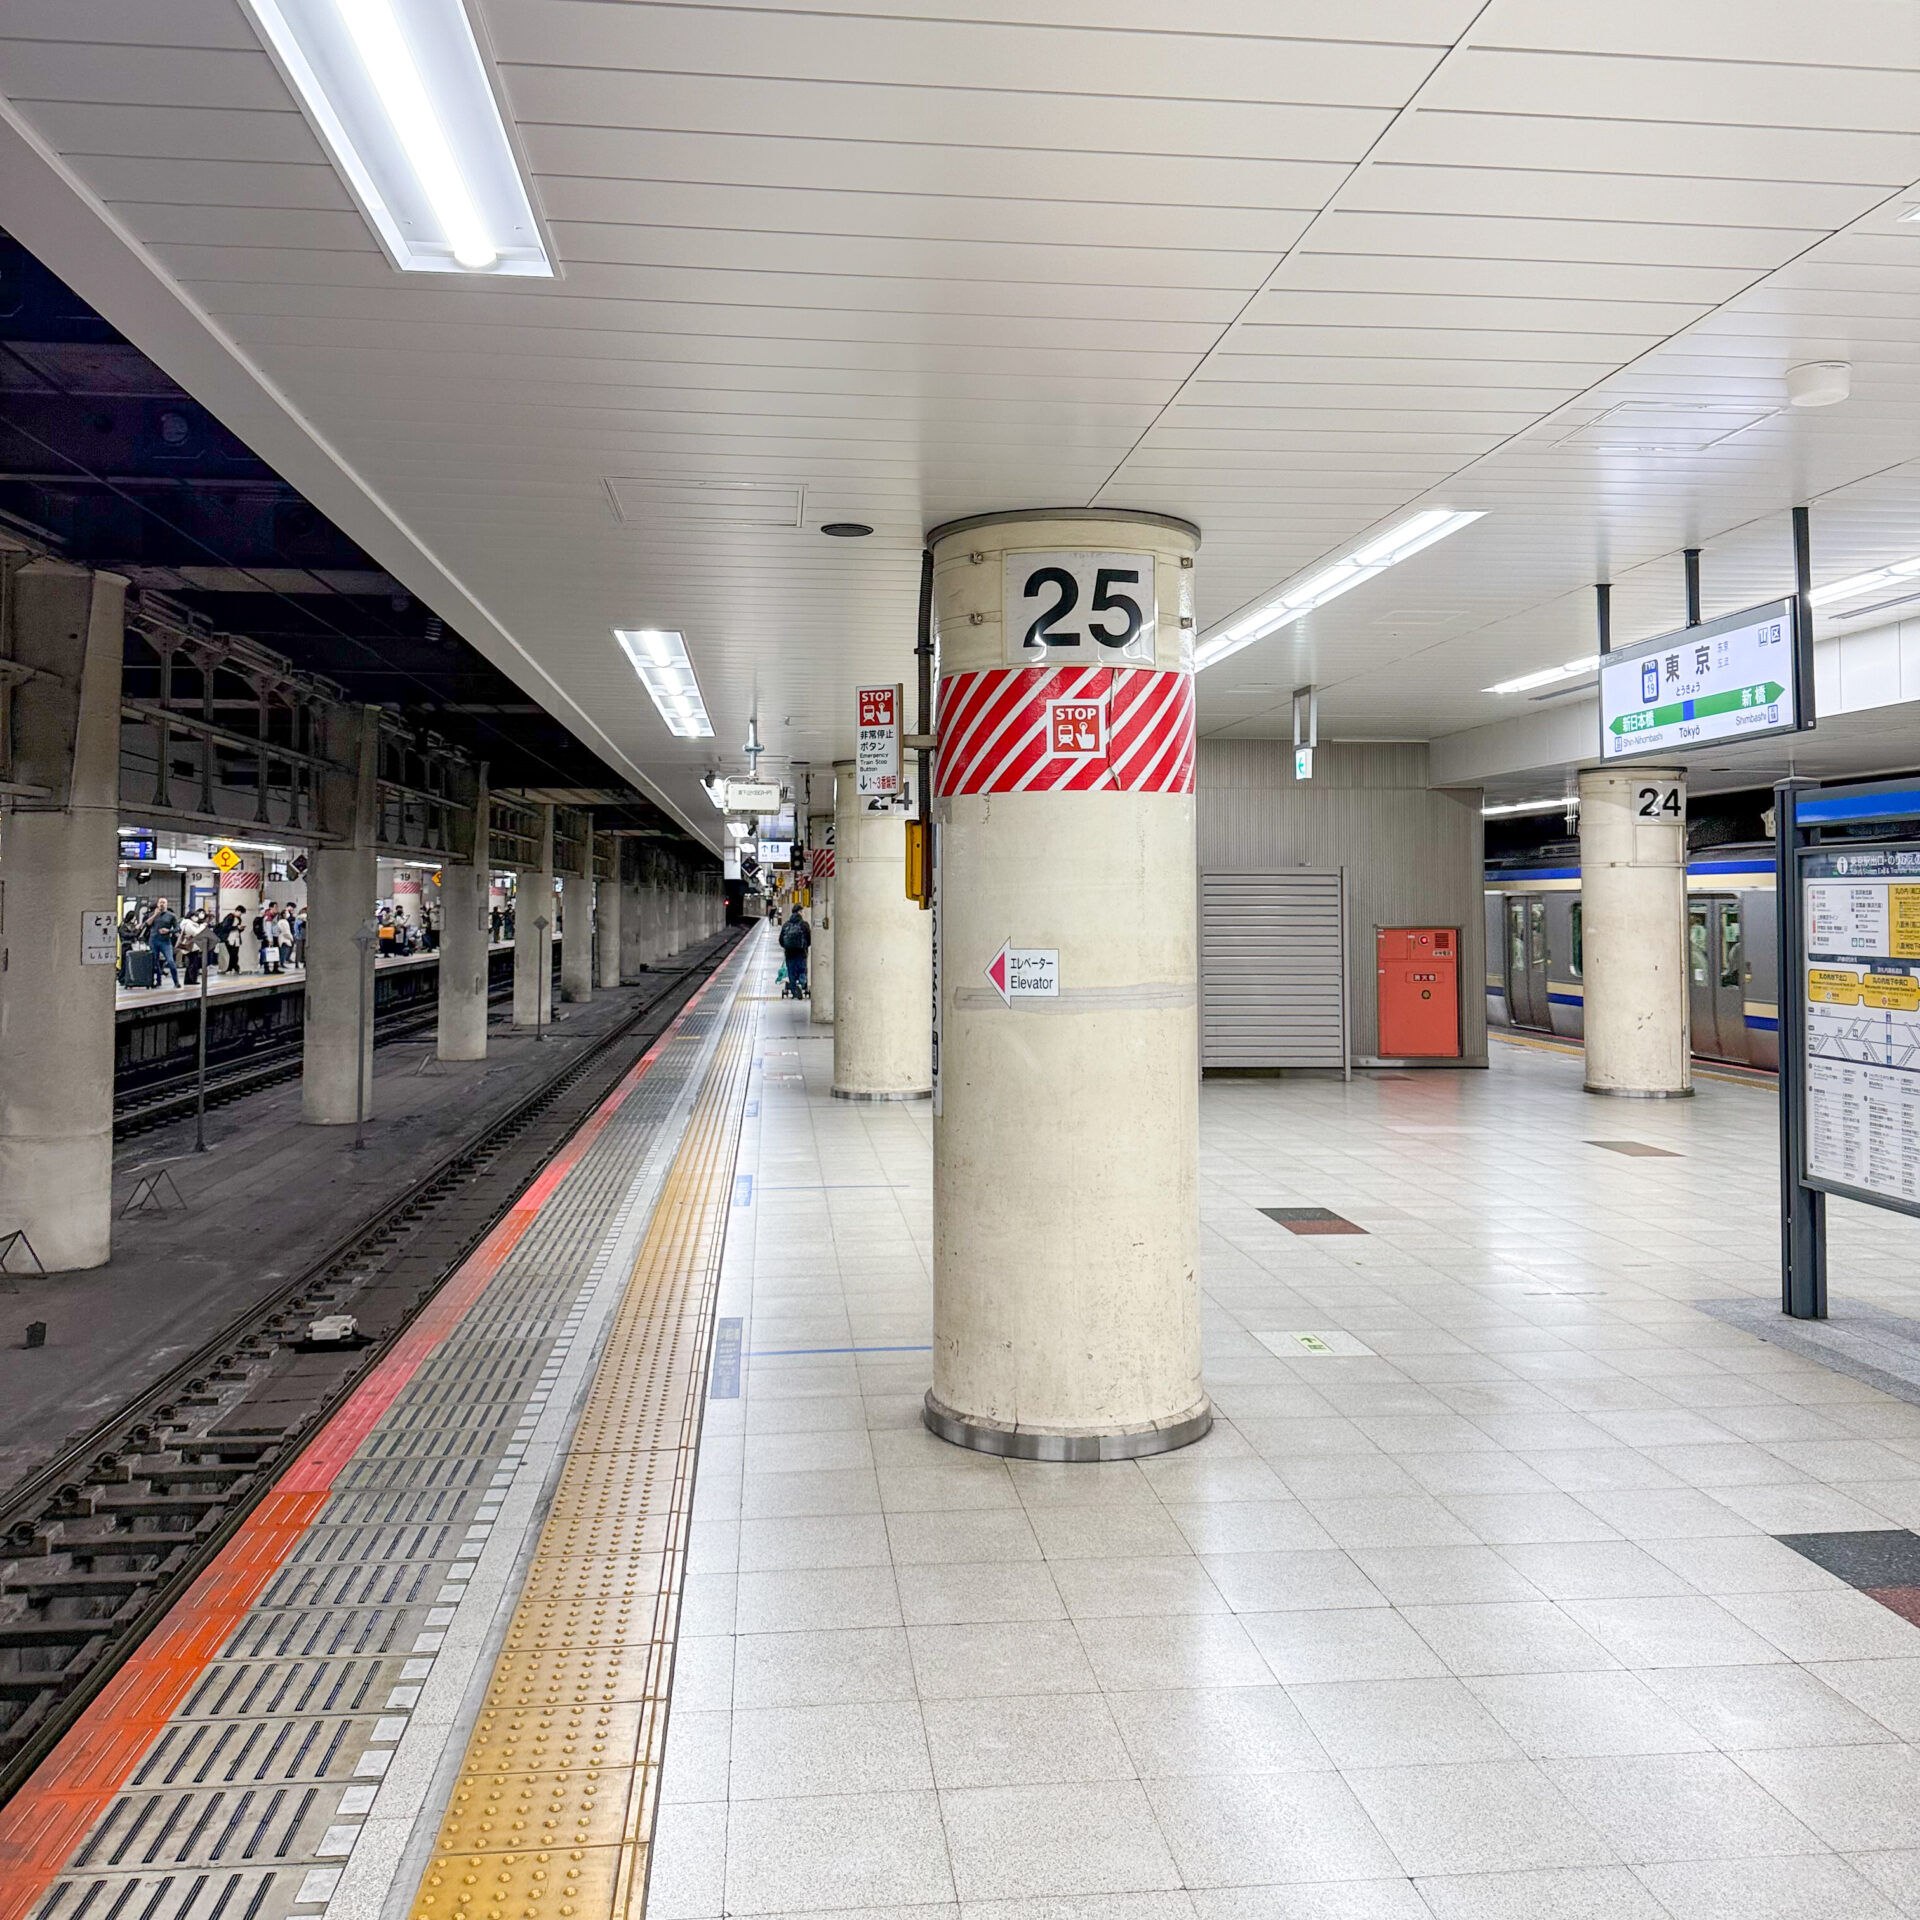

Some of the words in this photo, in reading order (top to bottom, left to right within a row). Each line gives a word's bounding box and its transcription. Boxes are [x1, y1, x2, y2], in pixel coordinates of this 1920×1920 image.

[1023, 567, 1143, 648] 25
[1665, 645, 1710, 682] 東京
[1647, 683, 1655, 695] 19
[1676, 682, 1700, 696] とうきょう
[861, 691, 892, 703] STOP
[1056, 707, 1097, 721] STOP
[860, 729, 894, 740] 非常停止
[860, 741, 886, 752] ボタン
[1639, 788, 1681, 816] 24
[146, 842, 153, 852] 3
[400, 873, 410, 881] 19
[1010, 957, 1053, 970] エレベーター
[1010, 975, 1054, 989] Elevator
